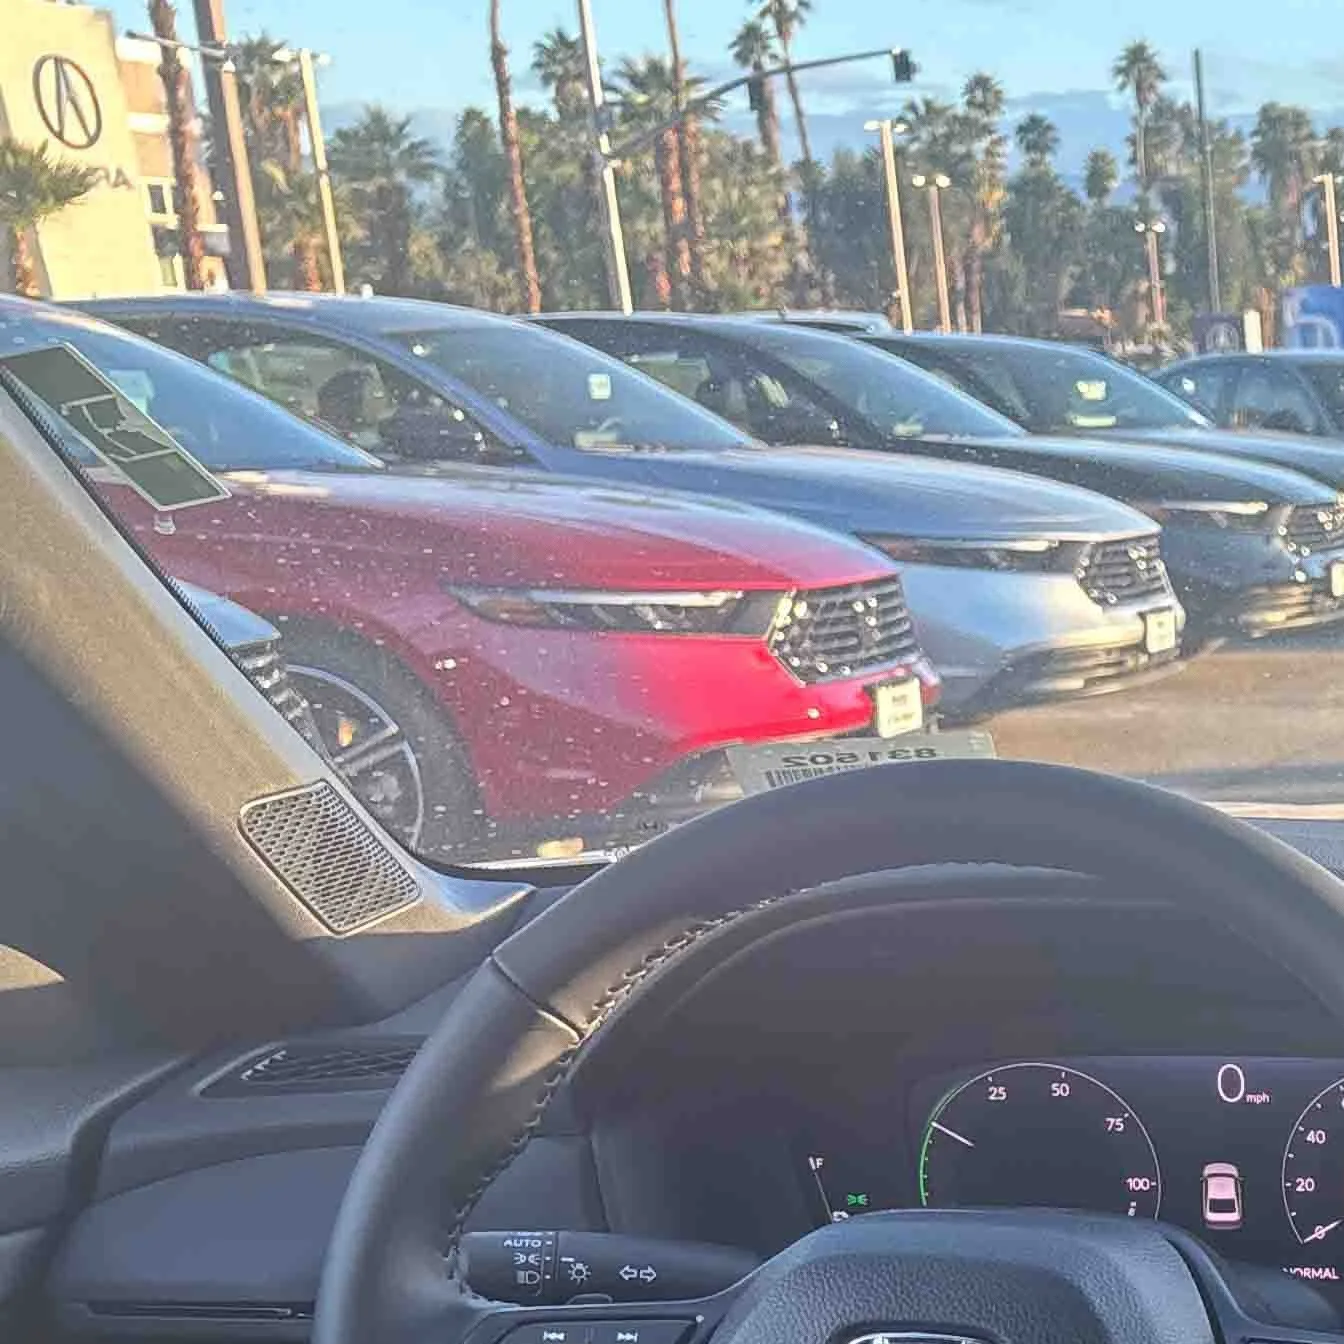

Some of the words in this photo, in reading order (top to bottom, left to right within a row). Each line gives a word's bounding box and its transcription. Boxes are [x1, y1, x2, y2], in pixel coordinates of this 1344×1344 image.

[1051, 1083, 1070, 1097] 50
[1217, 1064, 1245, 1102] 0
[1246, 1093, 1270, 1105] mph
[988, 1086, 1007, 1100] 25
[1105, 1118, 1124, 1132] 75
[1306, 1130, 1326, 1144] 40
[1126, 1177, 1150, 1191] 100
[1295, 1178, 1315, 1192] 20
[504, 1239, 542, 1248] AUTO
